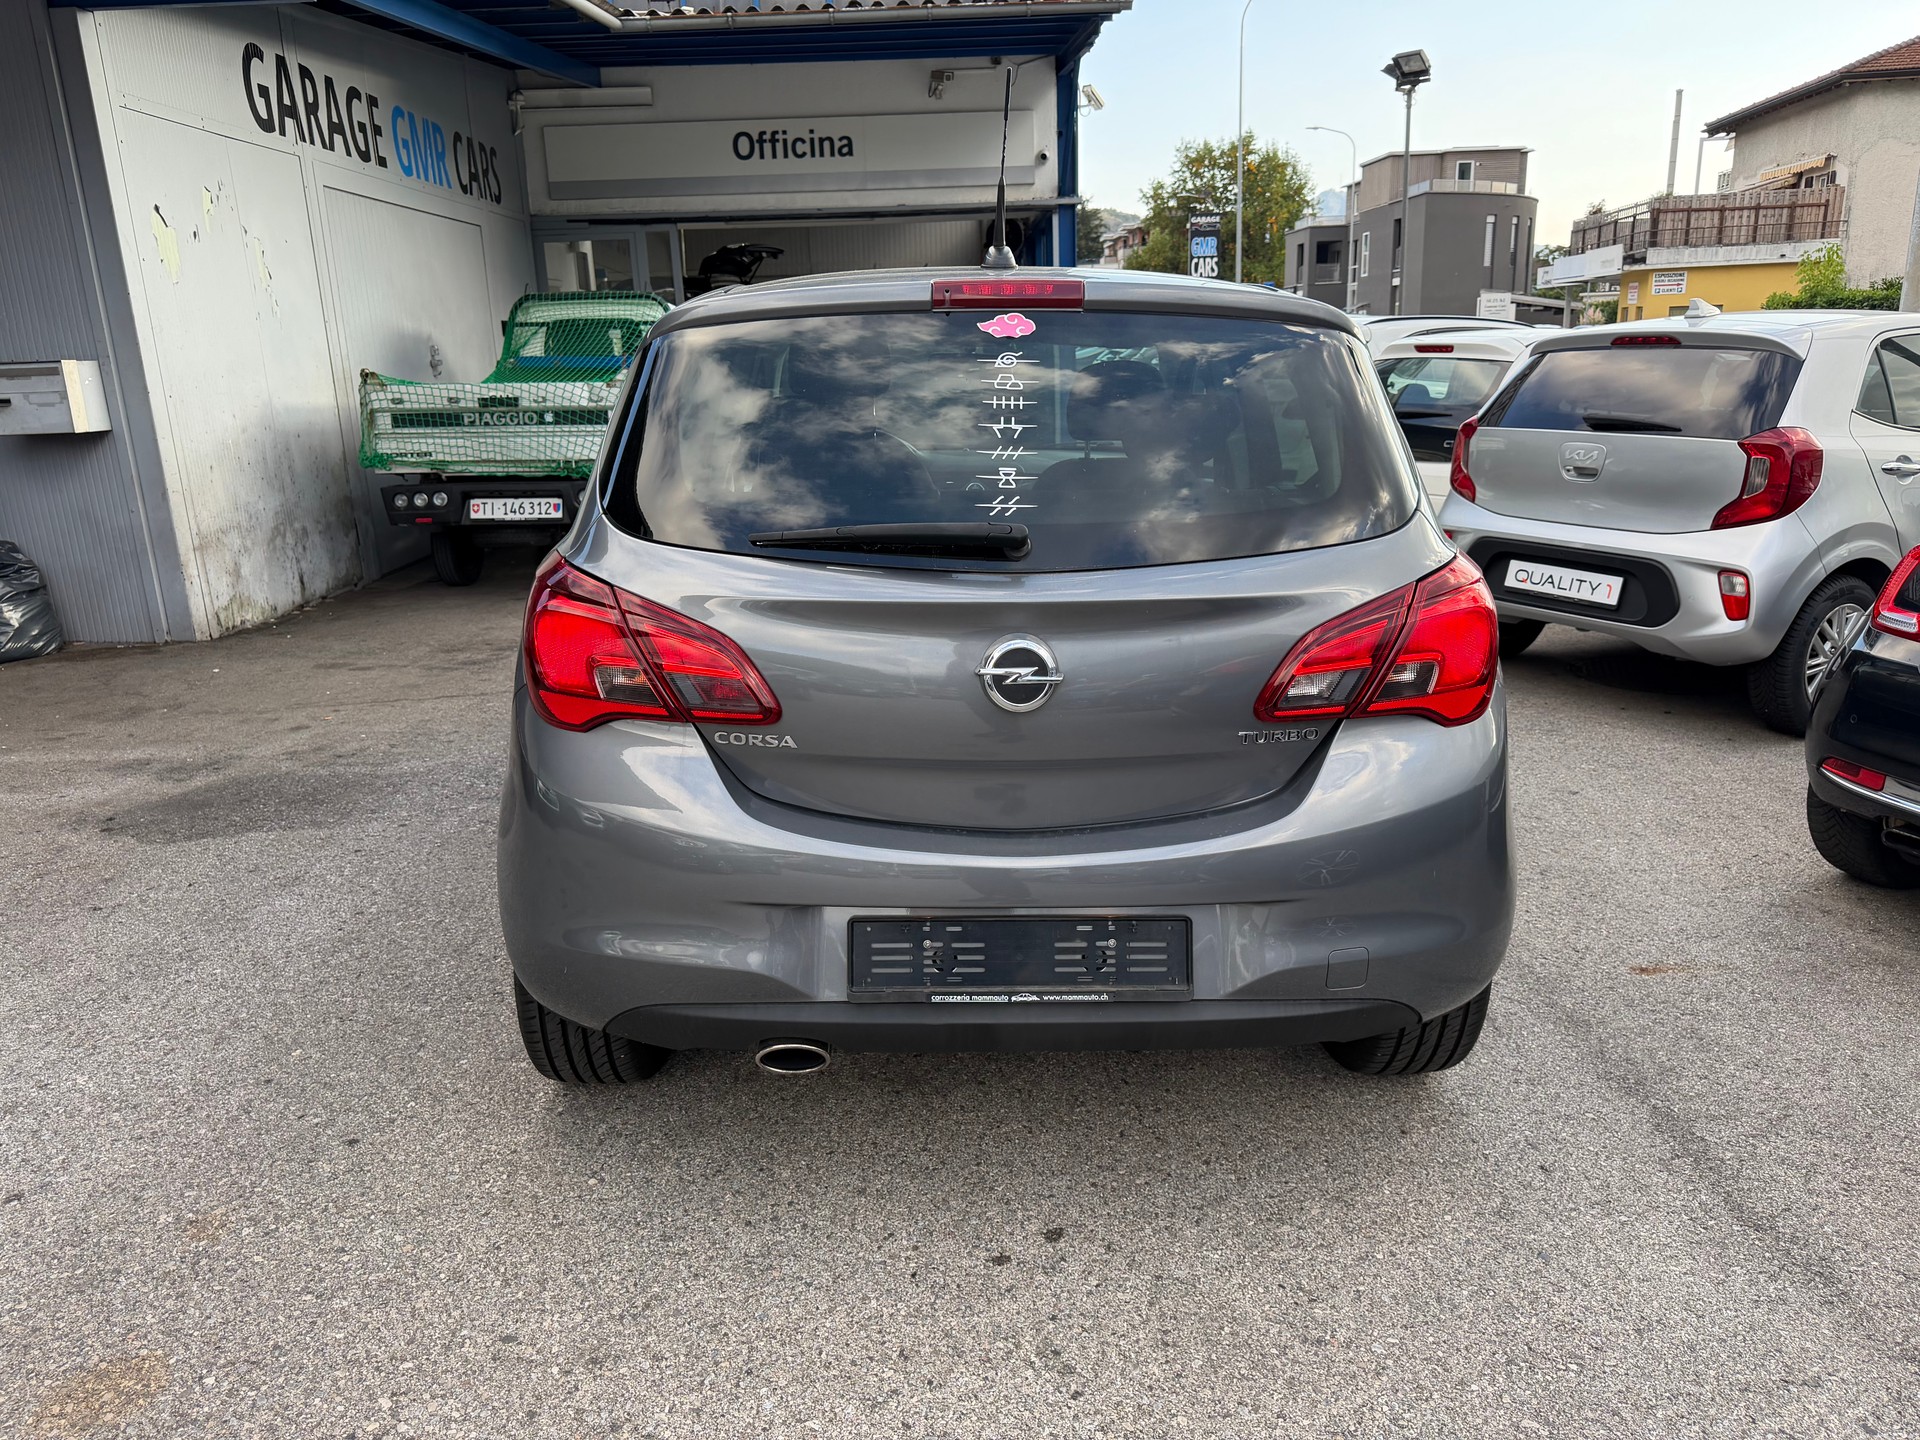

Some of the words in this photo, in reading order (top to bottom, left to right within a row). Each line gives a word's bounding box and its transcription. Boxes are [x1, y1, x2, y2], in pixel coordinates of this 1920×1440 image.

[242, 42, 388, 169] GARAGE
[391, 105, 452, 189] GMR
[453, 131, 502, 205] CARS
[732, 129, 854, 161] Officina
[1191, 237, 1218, 257] GMR
[1191, 258, 1218, 276] CARS
[463, 412, 537, 426] PIAGGIO
[1515, 569, 1602, 596] QUALITY
[1606, 584, 1613, 599] 1
[714, 731, 798, 749] CORSA
[1238, 727, 1320, 745] TURBO
[931, 993, 971, 1001] carrozzeria
[1042, 993, 1109, 1001] www.mammauto.ch
